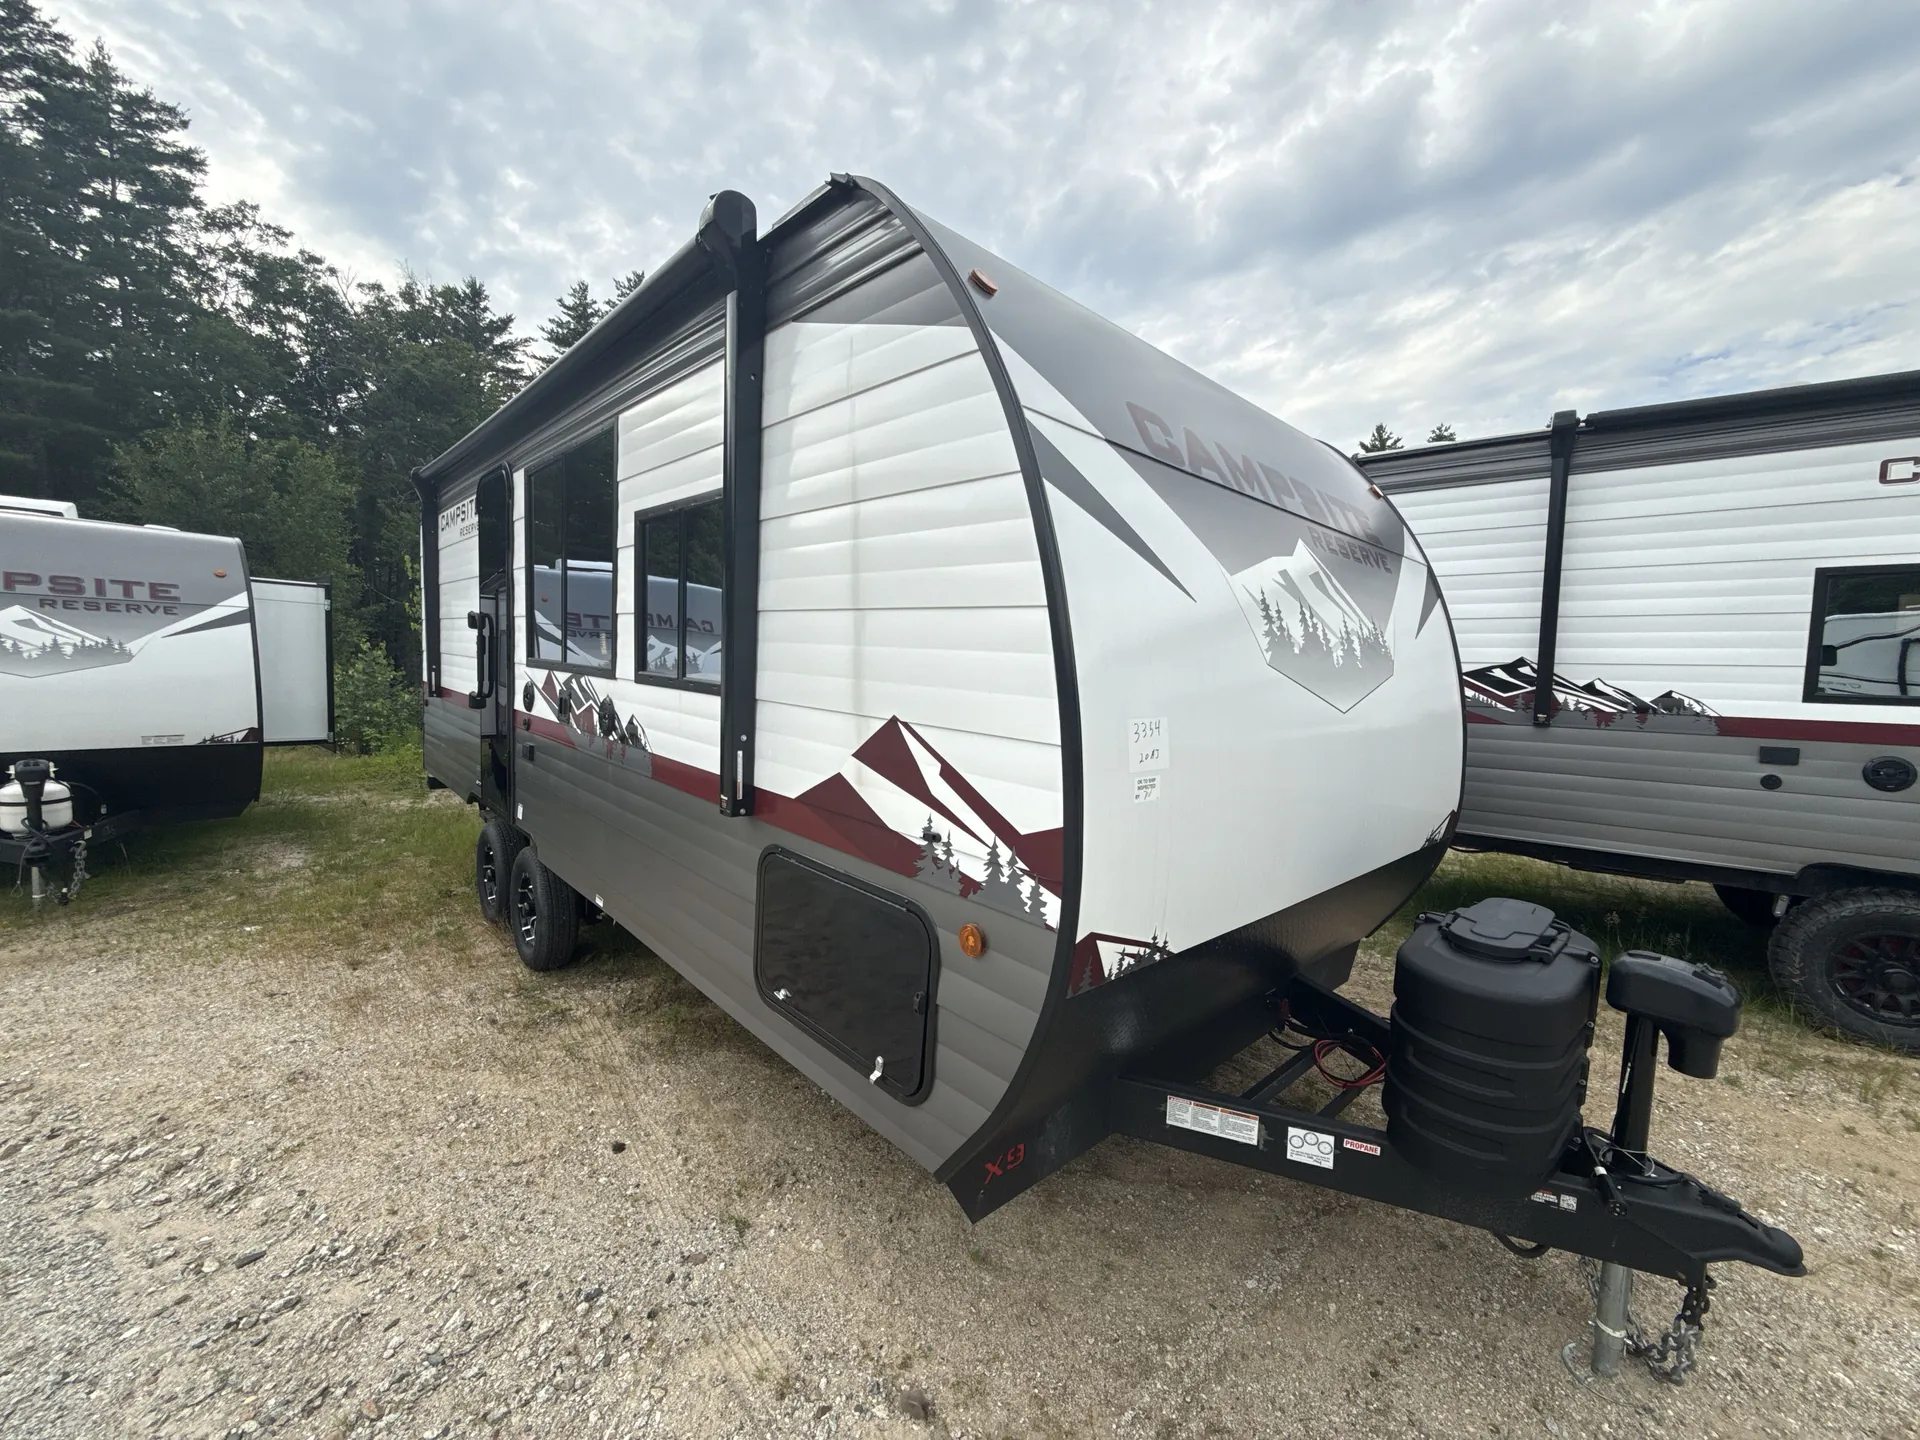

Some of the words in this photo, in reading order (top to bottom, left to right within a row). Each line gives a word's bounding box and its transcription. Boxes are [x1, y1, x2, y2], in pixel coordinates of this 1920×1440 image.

[1126, 401, 1385, 547] CAMPSITE
[441, 499, 478, 532] CAMPSIT
[1304, 525, 1393, 575] RESERVE
[2, 571, 181, 602] PSITE
[38, 598, 179, 616] RESERVE
[1133, 719, 1160, 743] 3354
[1345, 1140, 1379, 1154] PROPANE
